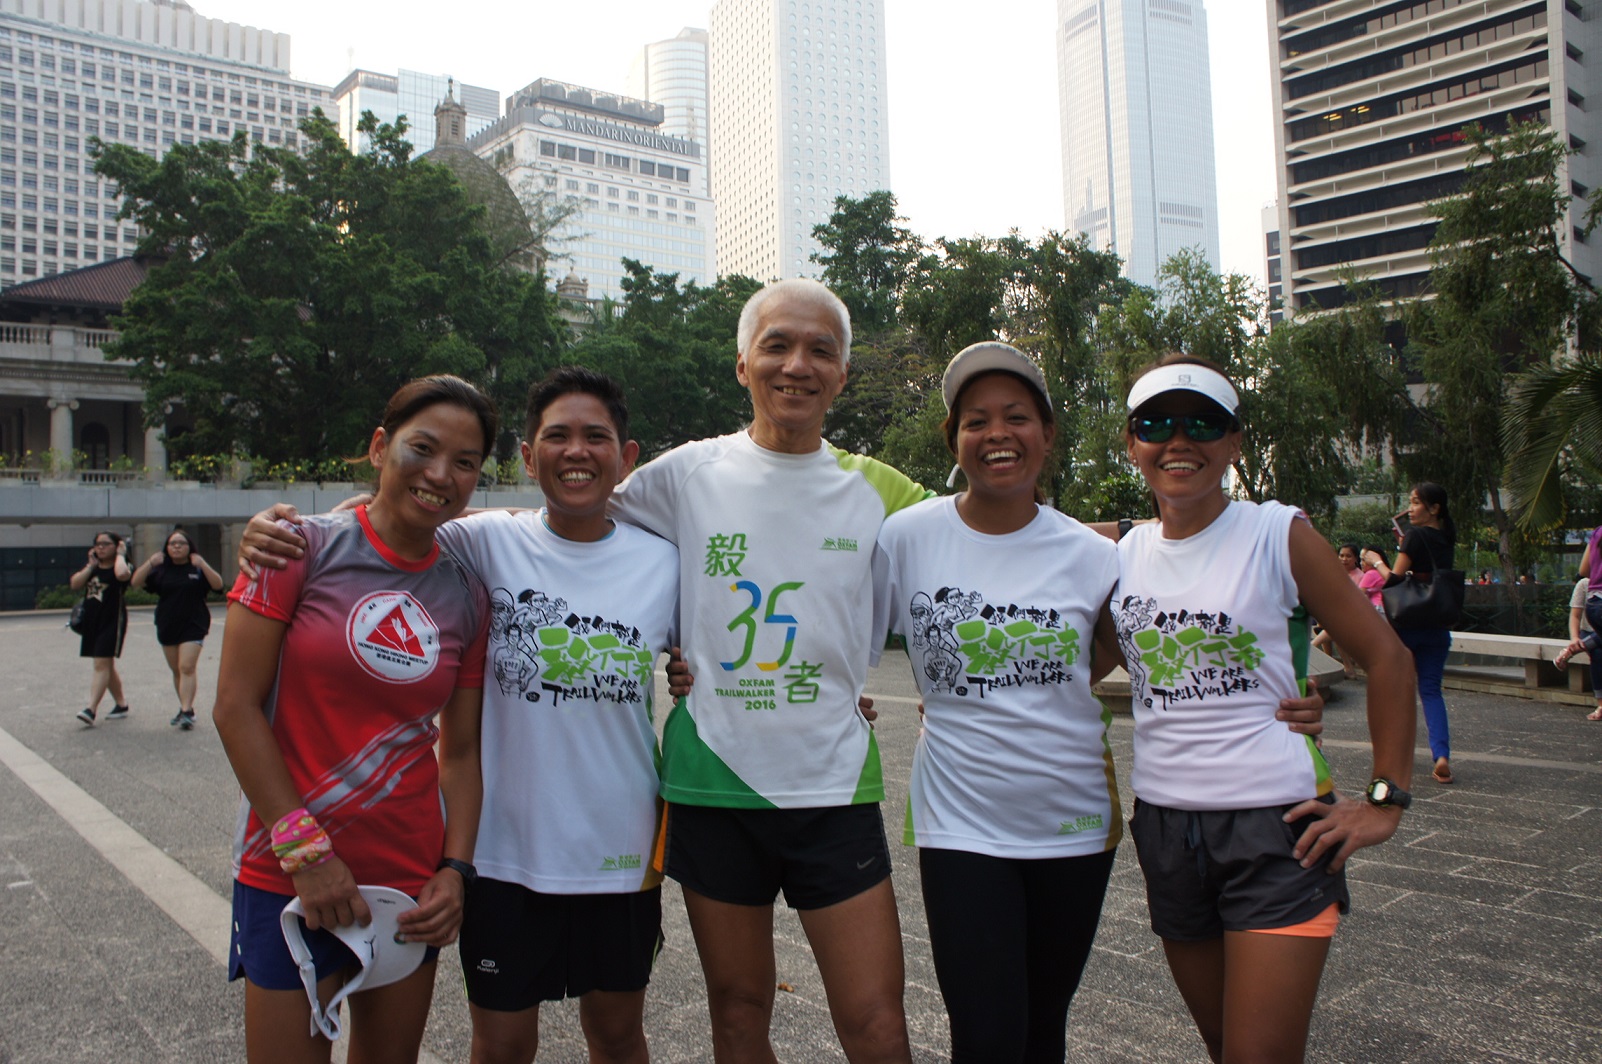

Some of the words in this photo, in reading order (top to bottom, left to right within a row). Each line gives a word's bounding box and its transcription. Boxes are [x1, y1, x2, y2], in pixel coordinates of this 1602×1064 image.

[566, 118, 632, 144] MANDARIN
[634, 133, 688, 155] ORIENTAL
[704, 533, 748, 577] 毅
[719, 580, 806, 671] 35
[374, 646, 389, 655] KONG
[408, 655, 429, 665] MEETUP
[537, 627, 653, 686] 毅行者
[957, 620, 1080, 675] 毅行者
[1135, 625, 1265, 687] 毅行者
[1013, 659, 1040, 674] WE
[1042, 661, 1064, 672] ARE
[1190, 667, 1218, 685] WE
[1221, 666, 1244, 679] ARE
[593, 674, 619, 688] WE
[620, 679, 638, 690] ARE
[715, 688, 775, 697] TRAILWALKER
[739, 679, 775, 687] OXFAM
[782, 661, 824, 703] 者
[745, 699, 776, 710] 2016
